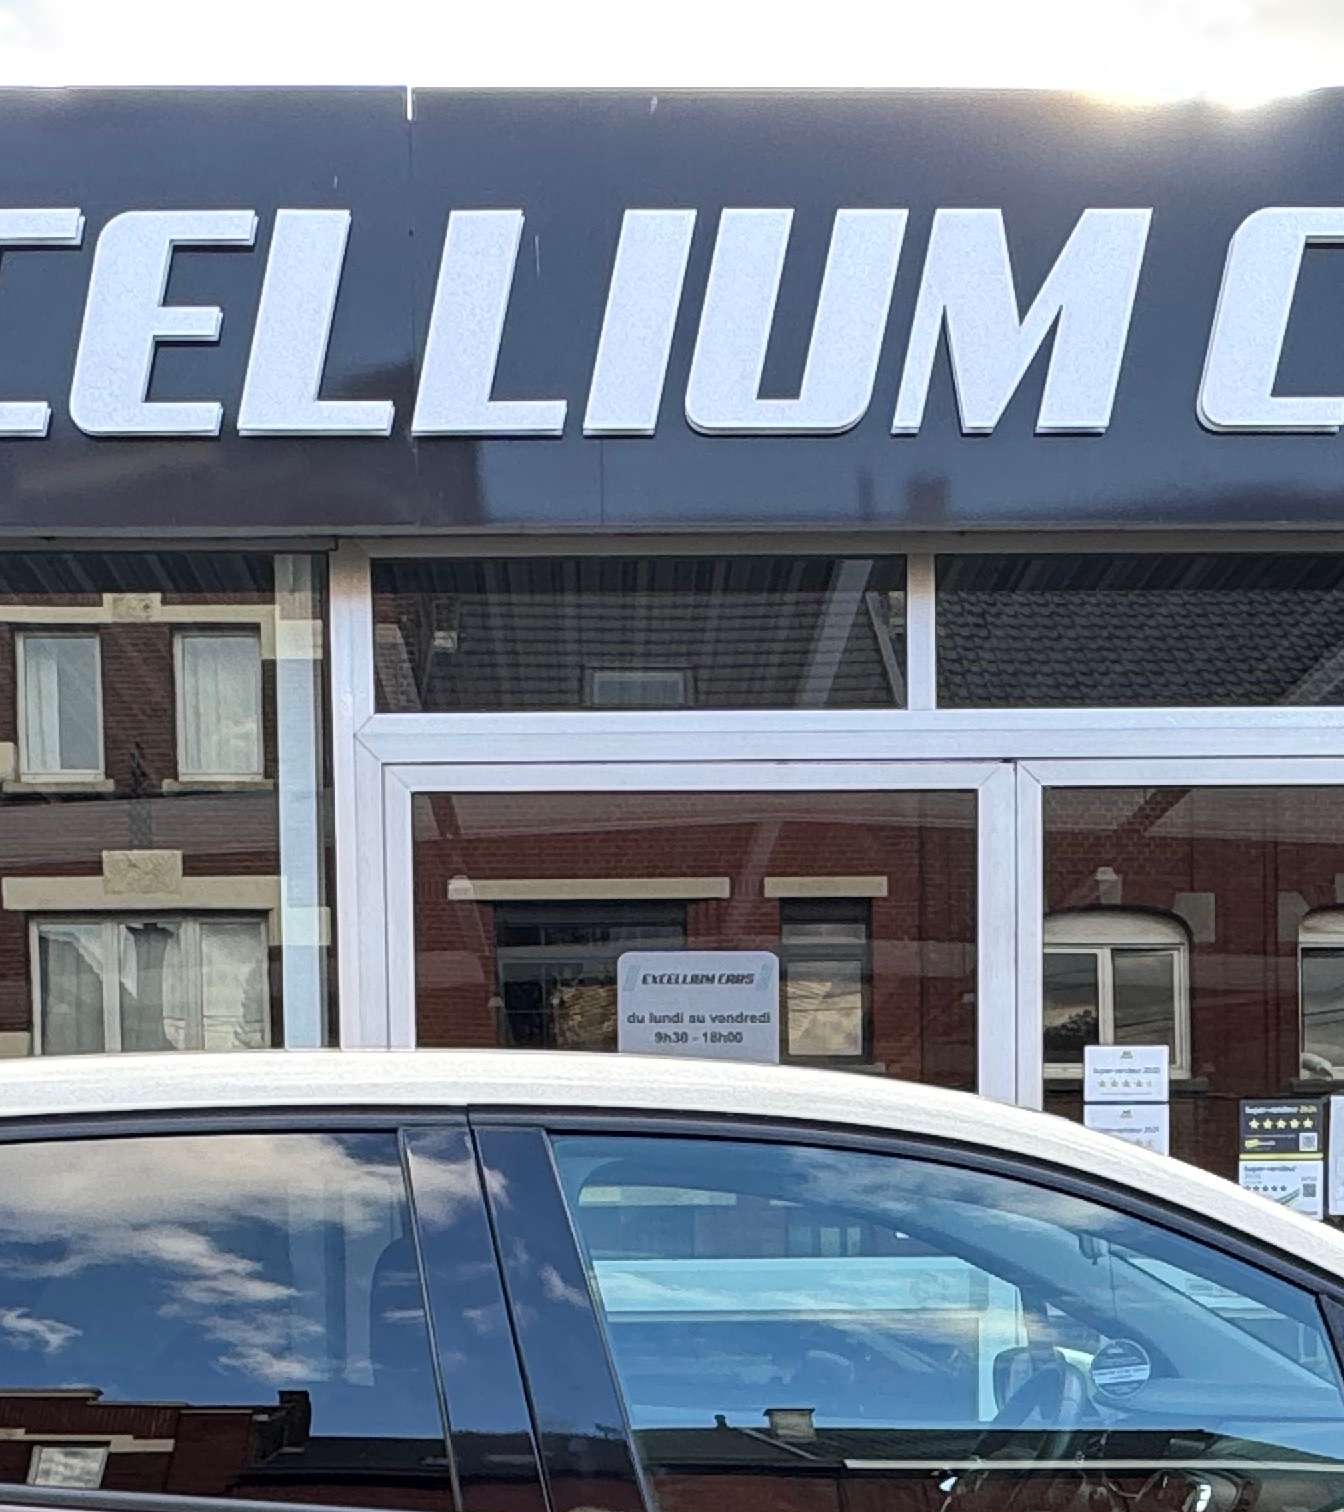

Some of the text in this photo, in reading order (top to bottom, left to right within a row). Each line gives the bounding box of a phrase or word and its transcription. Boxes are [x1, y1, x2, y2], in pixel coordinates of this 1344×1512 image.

[627, 1011, 771, 1025] du lundi au vendredi
